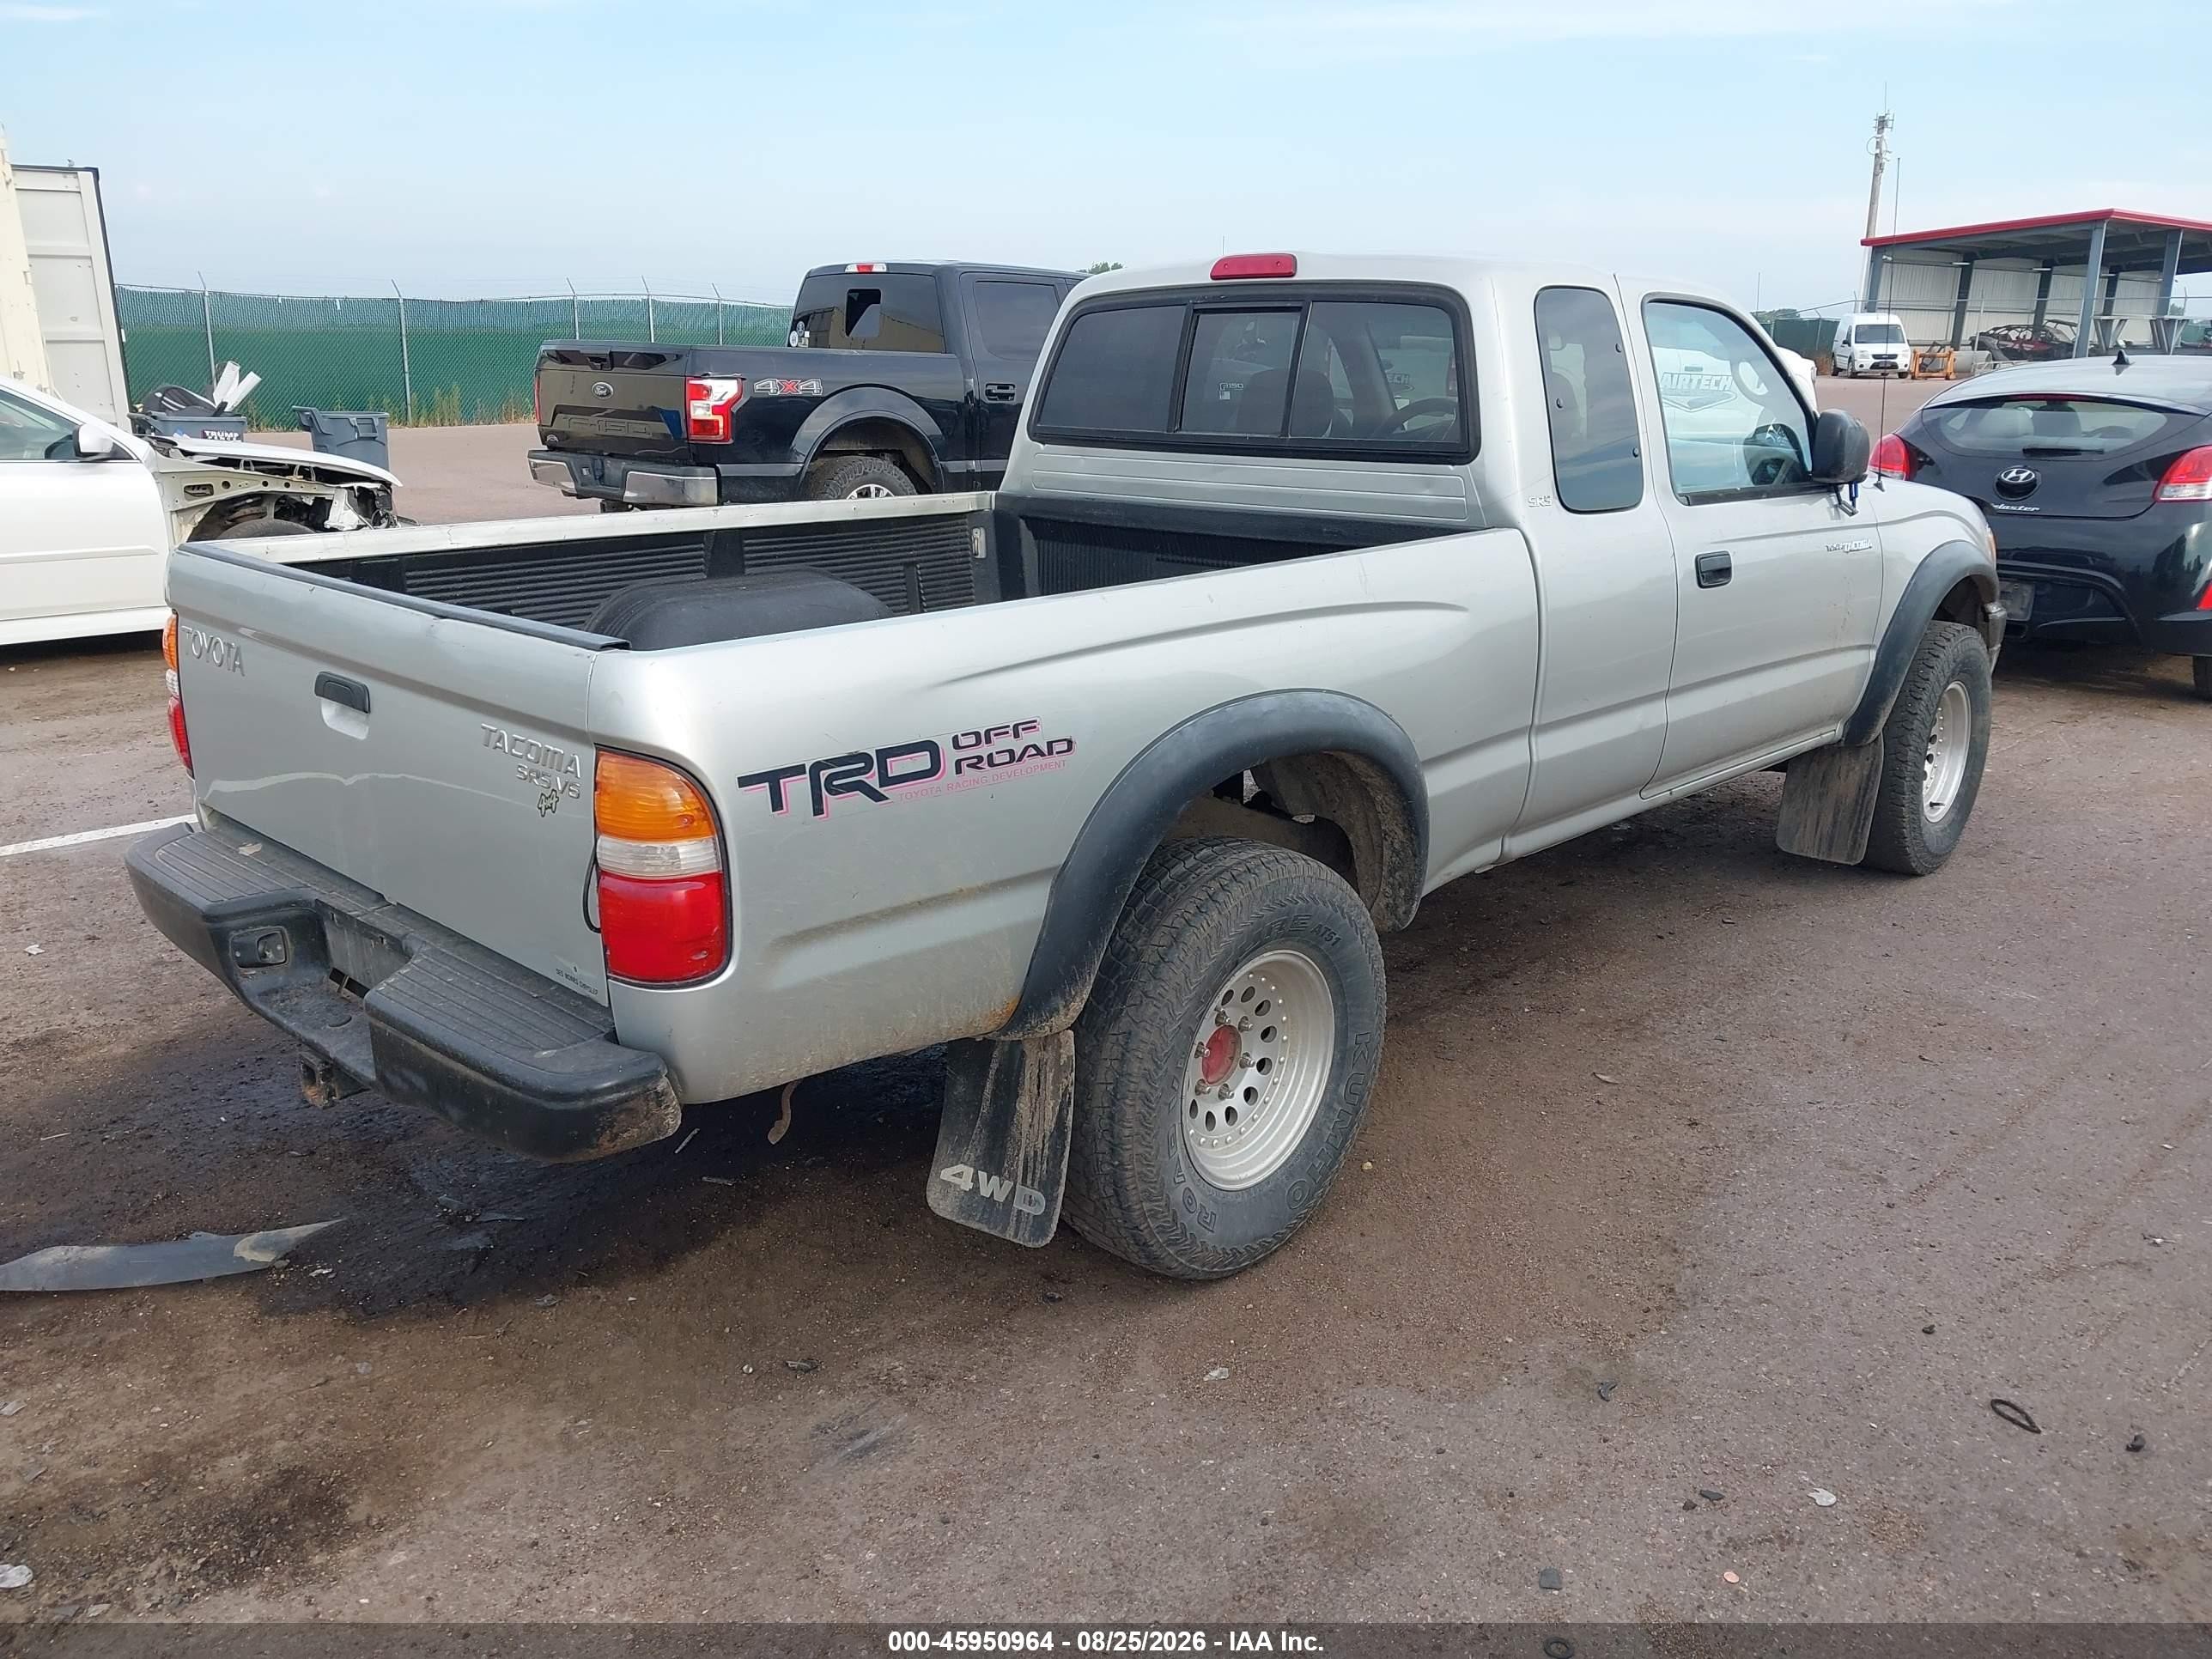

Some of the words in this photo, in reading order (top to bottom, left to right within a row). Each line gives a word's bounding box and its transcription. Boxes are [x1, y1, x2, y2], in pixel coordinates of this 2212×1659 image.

[563, 416, 653, 436] F-150
[181, 625, 246, 677] TOYOTA
[481, 723, 582, 779] TACOMA
[951, 719, 1041, 751] OFF
[954, 737, 1076, 776] ROAD
[516, 763, 551, 789] SR5
[556, 776, 581, 799] V6
[737, 739, 945, 819] TRD
[899, 786, 942, 801] TOYOTA
[947, 776, 988, 792] RACING
[992, 760, 1067, 782] DEVELOPMENT
[1285, 1032, 1372, 1210] KUMHO
[940, 1164, 1046, 1216] 4WD
